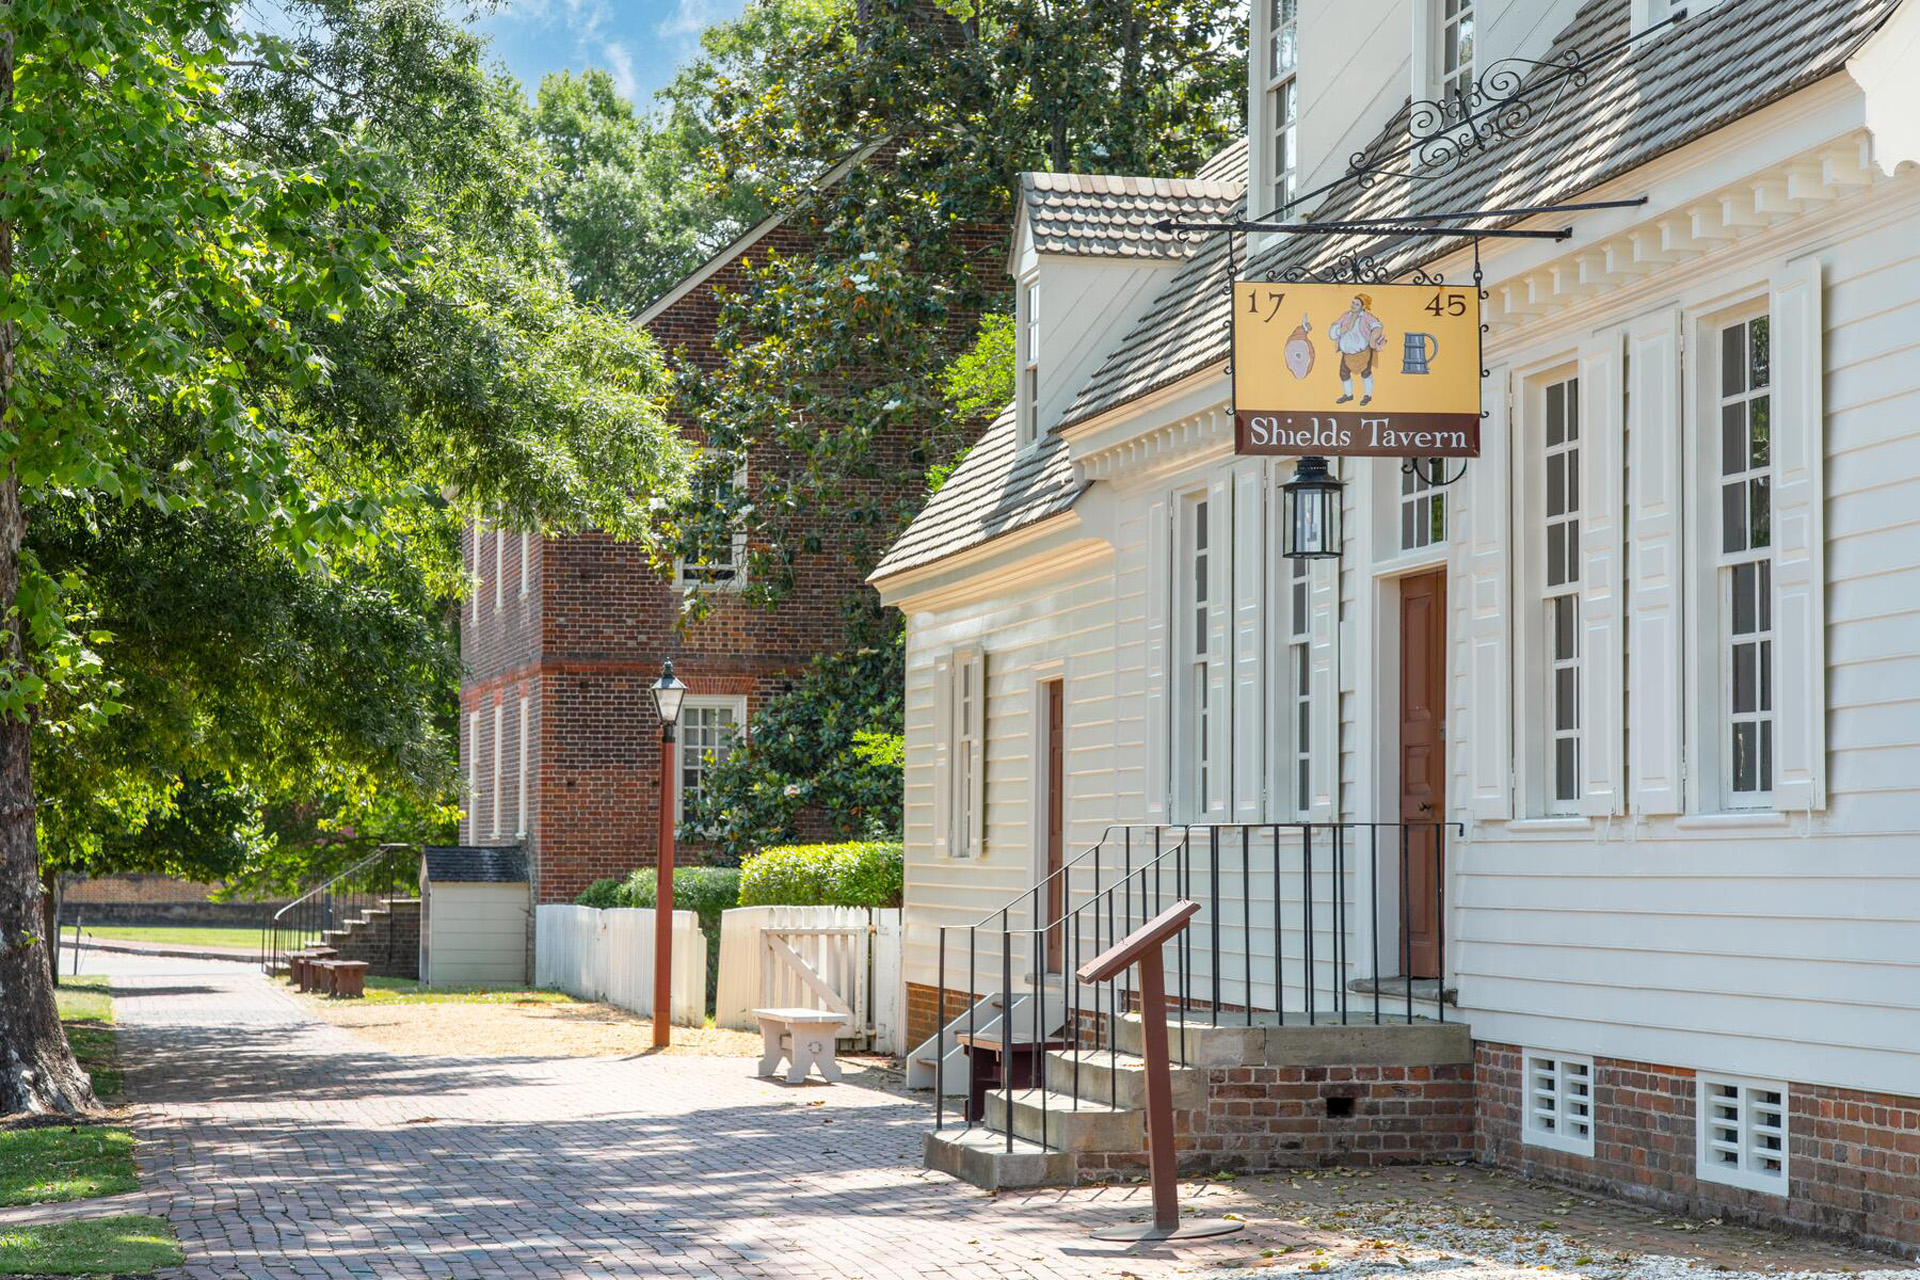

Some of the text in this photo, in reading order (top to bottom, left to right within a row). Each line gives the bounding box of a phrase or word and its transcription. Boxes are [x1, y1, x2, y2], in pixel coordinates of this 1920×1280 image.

[1248, 289, 1467, 322] 17 45
[1250, 417, 1468, 448] Shields Tavern
